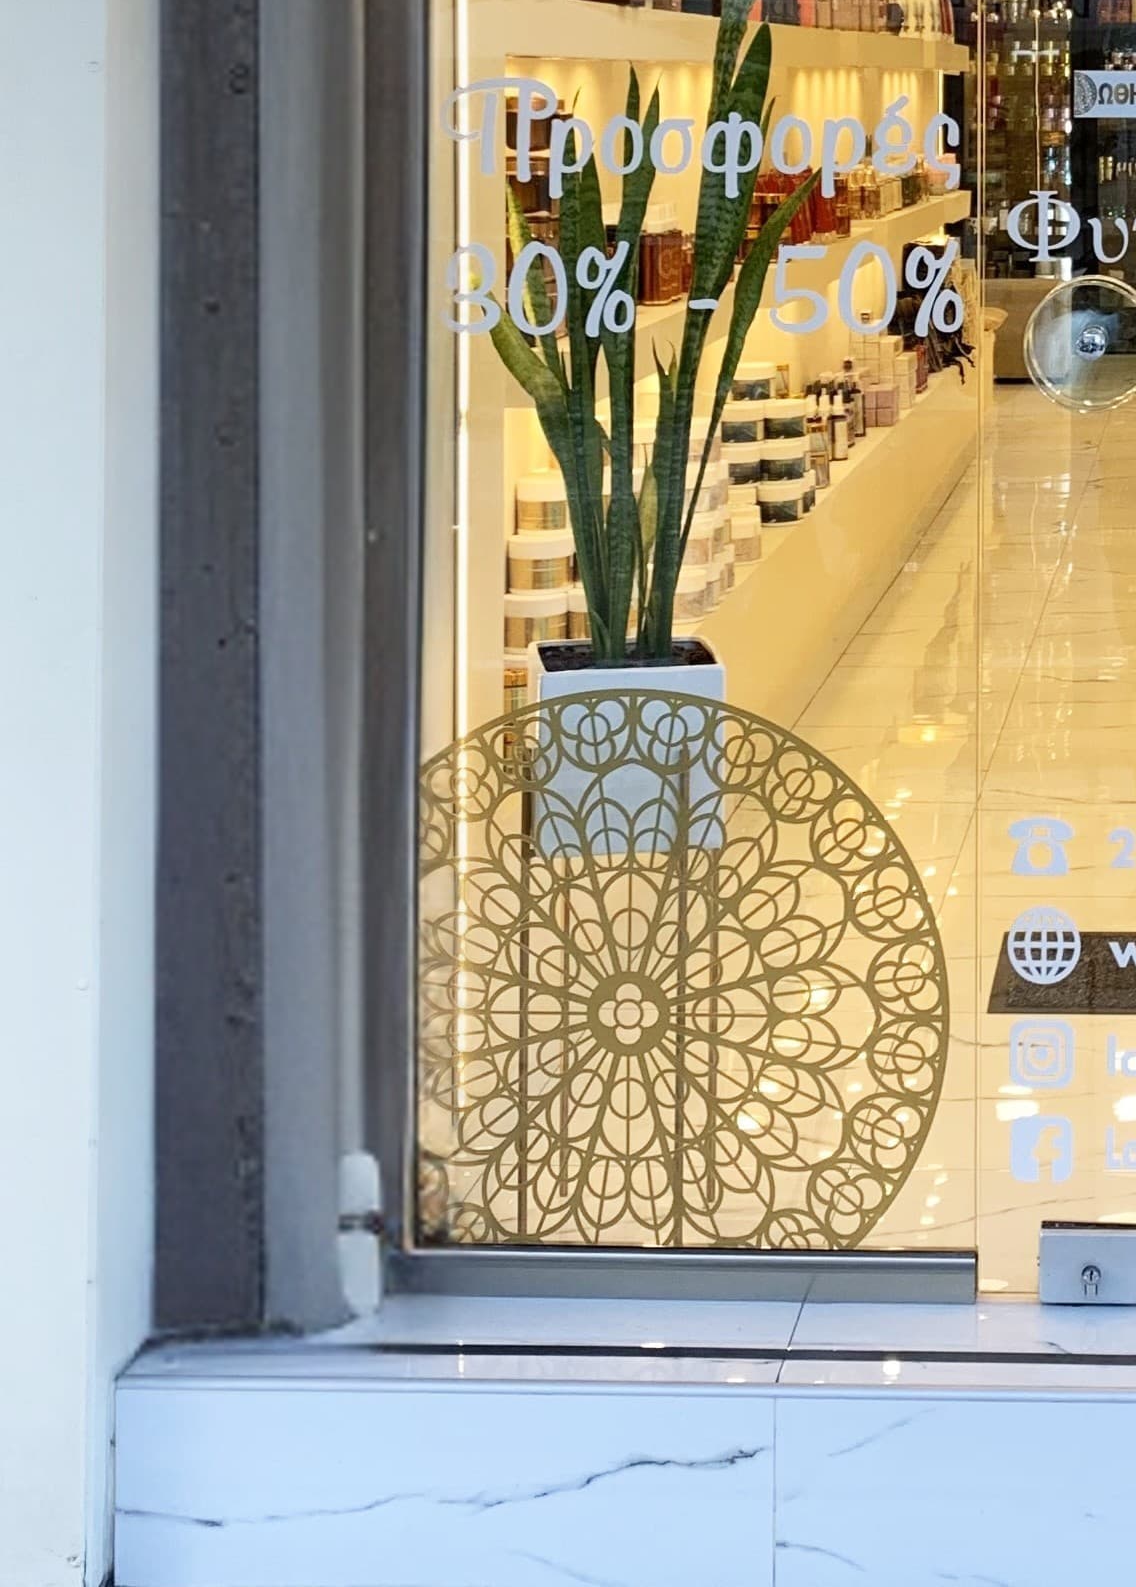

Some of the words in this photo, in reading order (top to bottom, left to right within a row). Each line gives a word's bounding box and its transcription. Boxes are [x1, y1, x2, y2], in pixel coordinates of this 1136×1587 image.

[439, 78, 962, 199] Προσφορές
[445, 240, 637, 337] 30%
[770, 239, 964, 337] 50%
